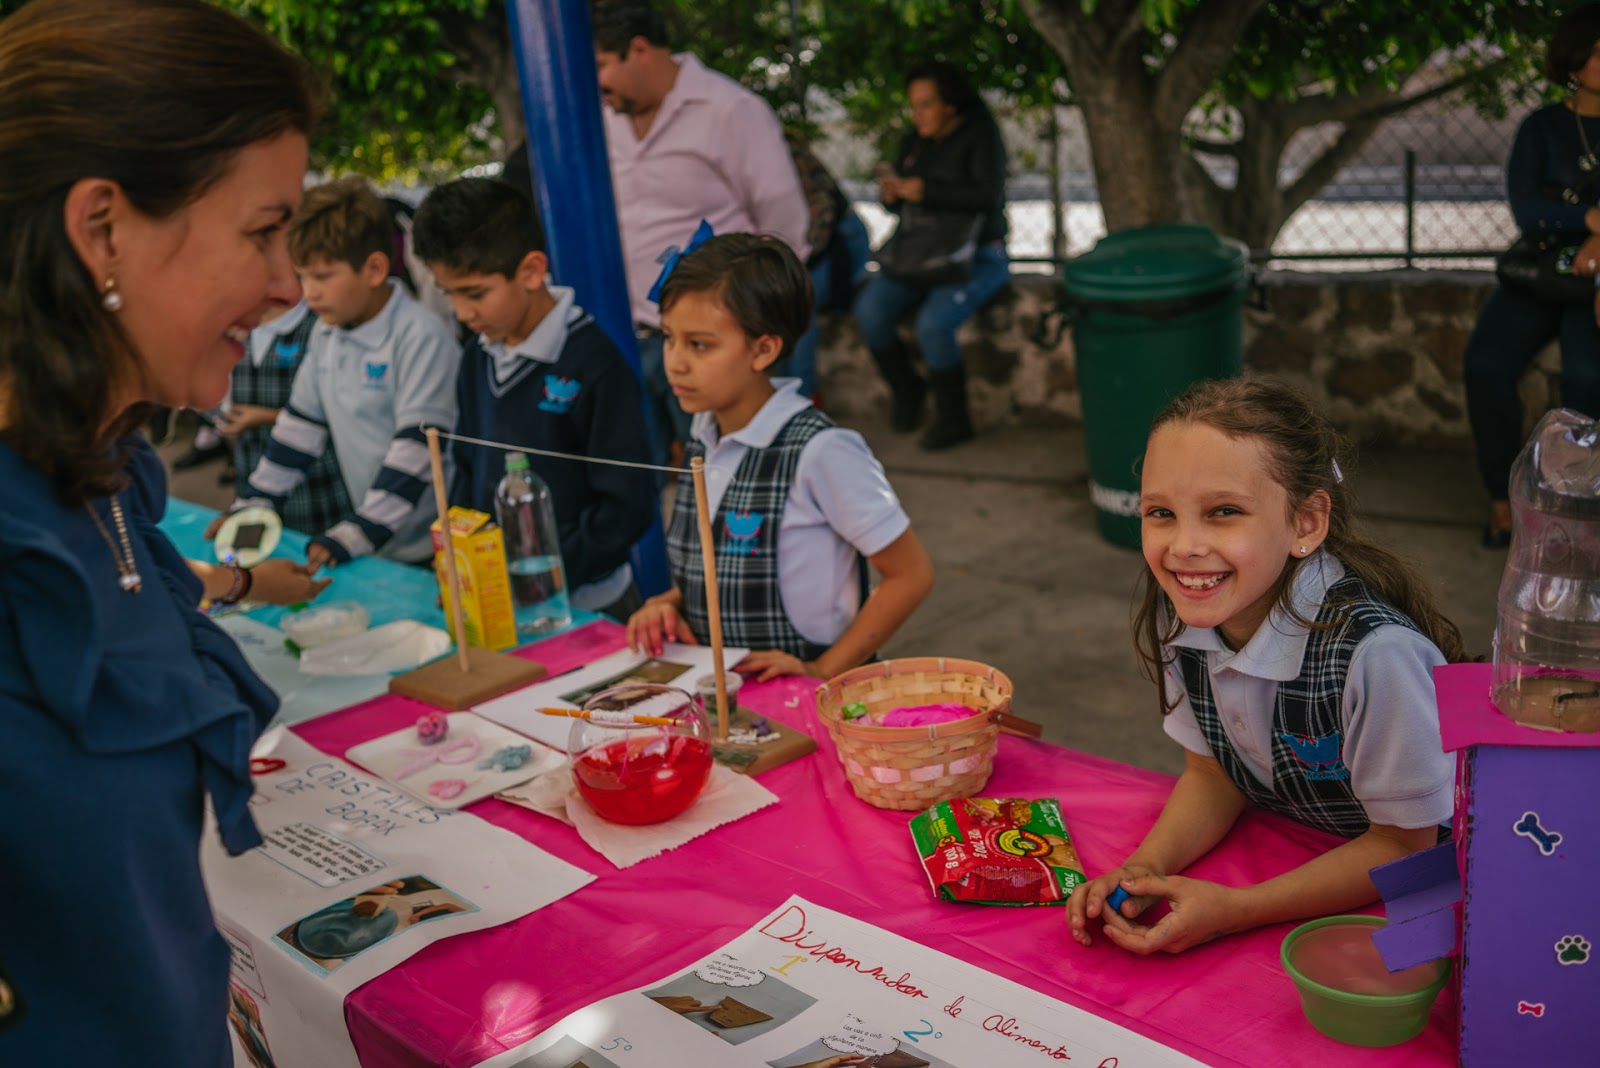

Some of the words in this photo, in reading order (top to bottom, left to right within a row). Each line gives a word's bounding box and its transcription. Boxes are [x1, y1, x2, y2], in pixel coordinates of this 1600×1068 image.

[275, 777, 316, 795] DE
[306, 762, 452, 825] CRISTALES
[1064, 872, 1075, 887] 700
[943, 995, 965, 1018] de
[827, 1035, 856, 1047] siguiente
[855, 1043, 877, 1054] manera
